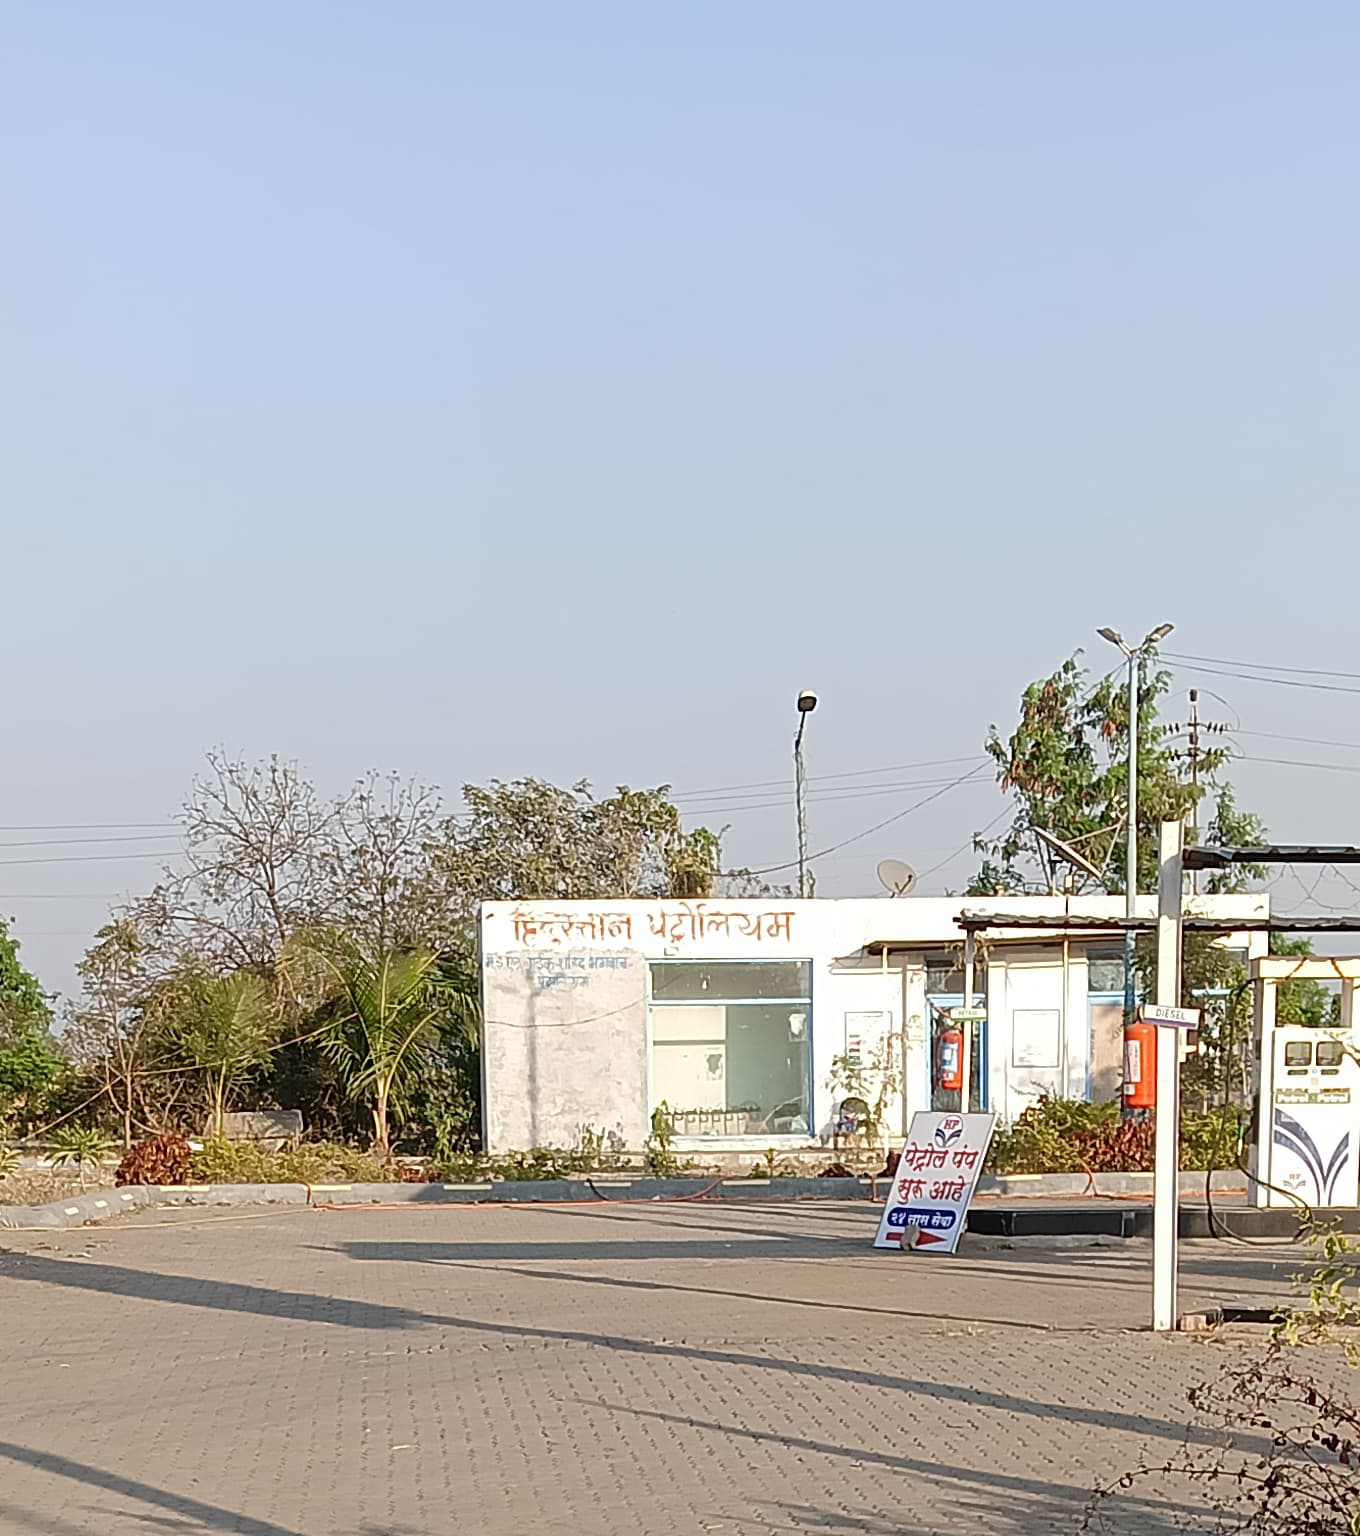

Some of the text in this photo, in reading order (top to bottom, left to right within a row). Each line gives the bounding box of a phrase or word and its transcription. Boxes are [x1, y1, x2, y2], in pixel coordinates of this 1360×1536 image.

[1156, 1008, 1186, 1020] DIESEL
[944, 1120, 960, 1130] HP
[905, 1142, 979, 1171] पेट्रोल पंप
[929, 1175, 966, 1200] आहे
